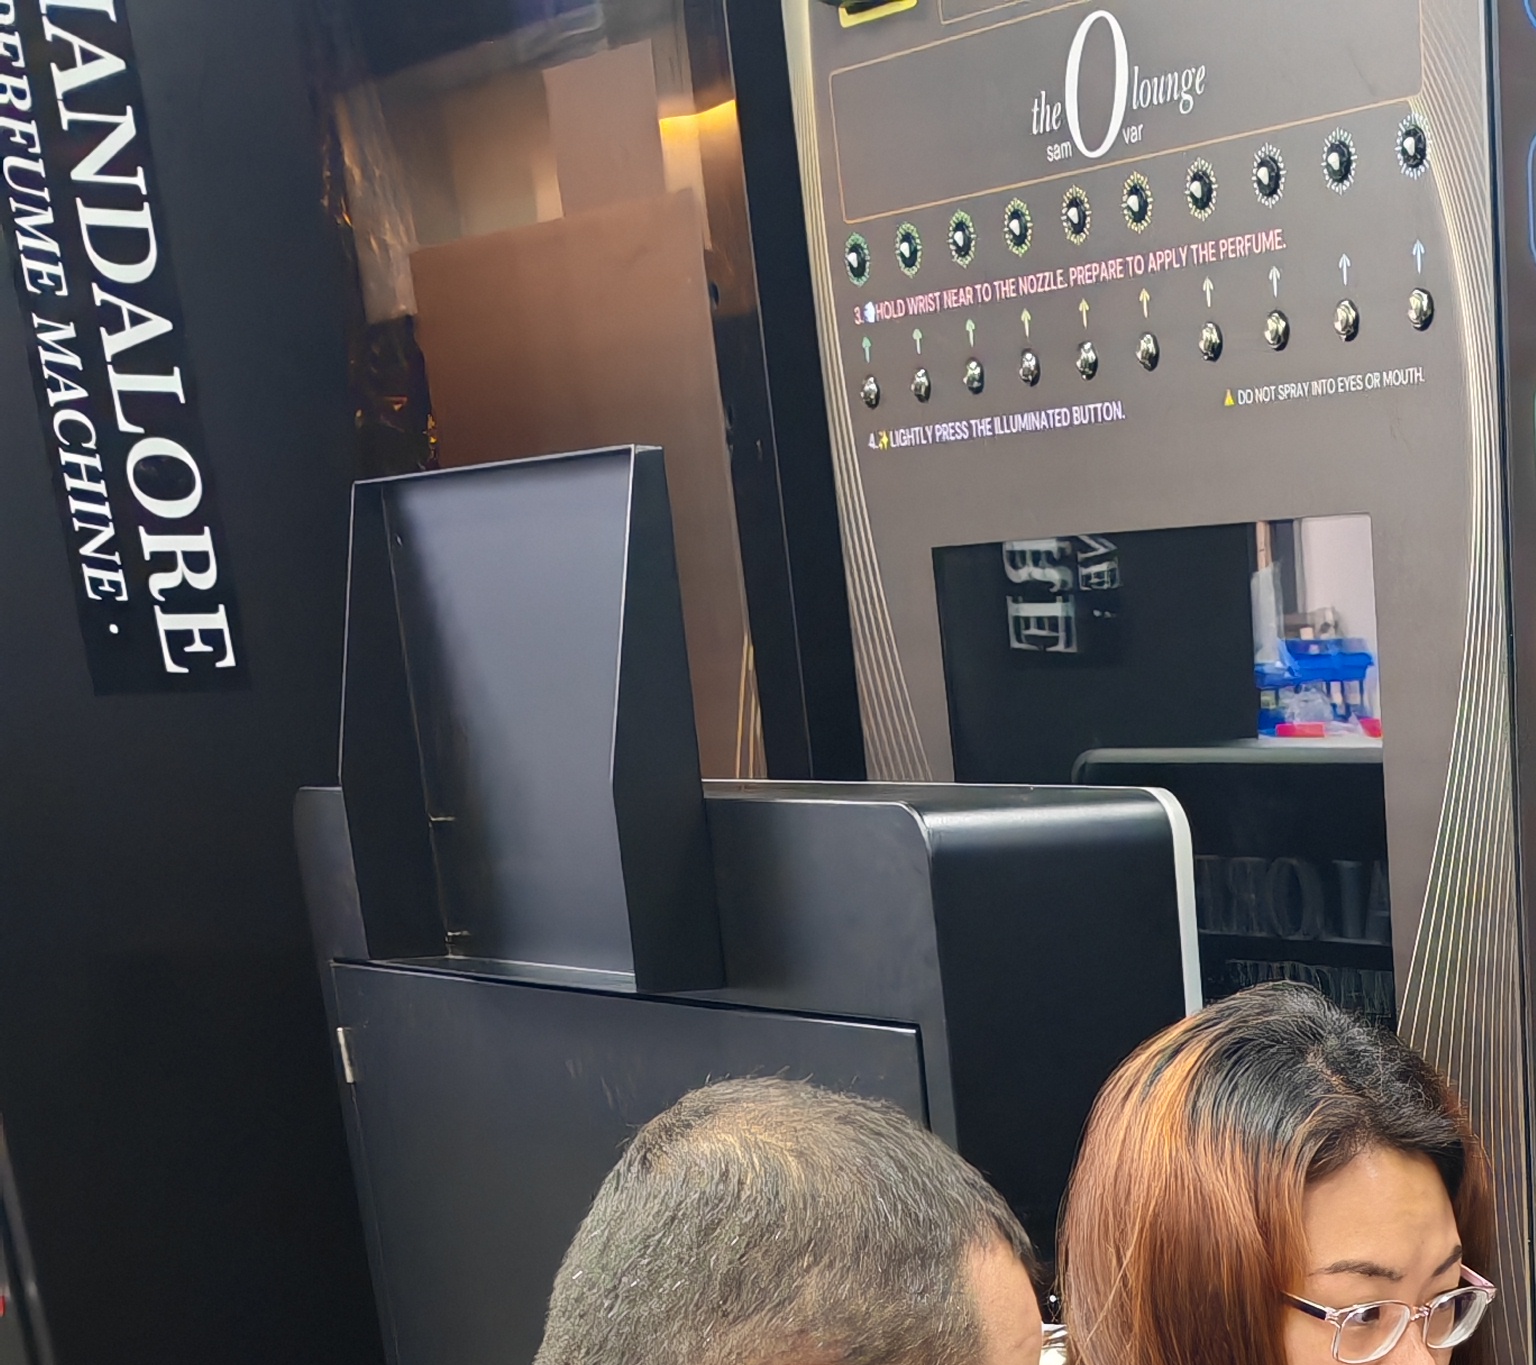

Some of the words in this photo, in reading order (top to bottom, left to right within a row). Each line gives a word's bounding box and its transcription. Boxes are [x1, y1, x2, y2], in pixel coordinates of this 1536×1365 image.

[1031, 90, 1062, 136] the
[1065, 9, 1129, 159] O
[1132, 64, 1206, 115] lounge
[1046, 140, 1073, 162] sam
[1122, 123, 1144, 145] var
[874, 299, 906, 321] HOLD
[906, 292, 942, 316] WRIST
[943, 285, 974, 310] NEAR
[975, 283, 992, 303] TO
[994, 278, 1018, 301] THE
[1069, 258, 1125, 288] PREPARE
[1126, 255, 1145, 277] TO
[1147, 244, 1189, 273] APPLY
[1190, 240, 1217, 265] THE
[1218, 228, 1287, 261] PERFUME.
[39, 0, 236, 674] ANDALORE
[1237, 388, 1254, 406] DO
[1254, 385, 1277, 404] NOT
[1277, 380, 1310, 401] SPRAY
[1310, 378, 1336, 397] INTO
[1337, 374, 1364, 394] EYES
[1364, 372, 1380, 390] OR
[889, 424, 934, 449] LIGHTLY
[935, 421, 969, 443] PRESS
[970, 416, 993, 439] THE
[993, 407, 1071, 436] ILLUMINATED
